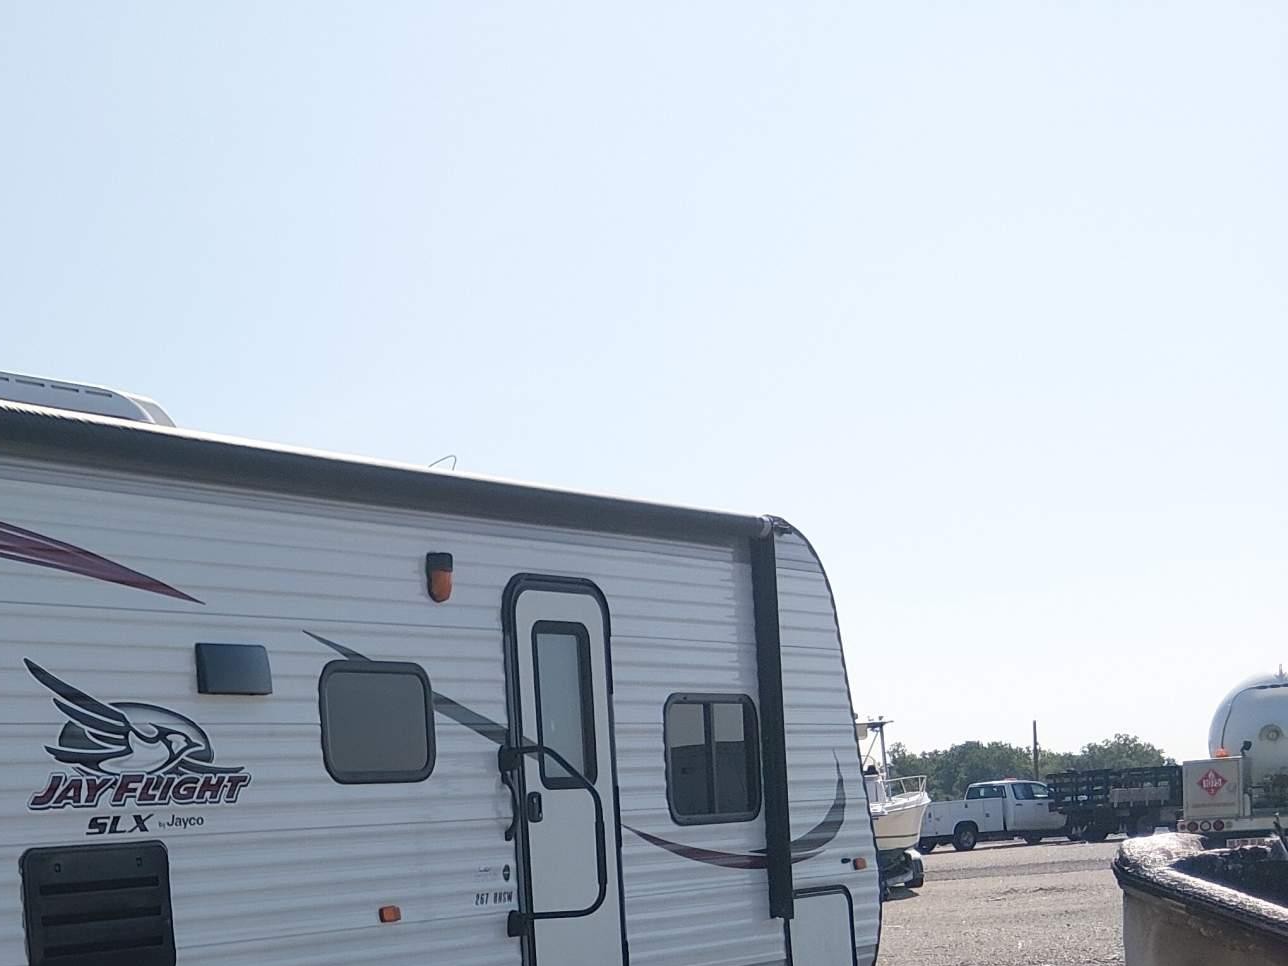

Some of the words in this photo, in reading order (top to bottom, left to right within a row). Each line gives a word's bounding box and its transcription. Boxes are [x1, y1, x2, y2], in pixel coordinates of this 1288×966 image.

[28, 772, 115, 810] JAY
[110, 769, 251, 807] FLIGHT
[85, 814, 154, 835] SLX
[166, 814, 204, 829] Jayco
[475, 892, 489, 906] 267
